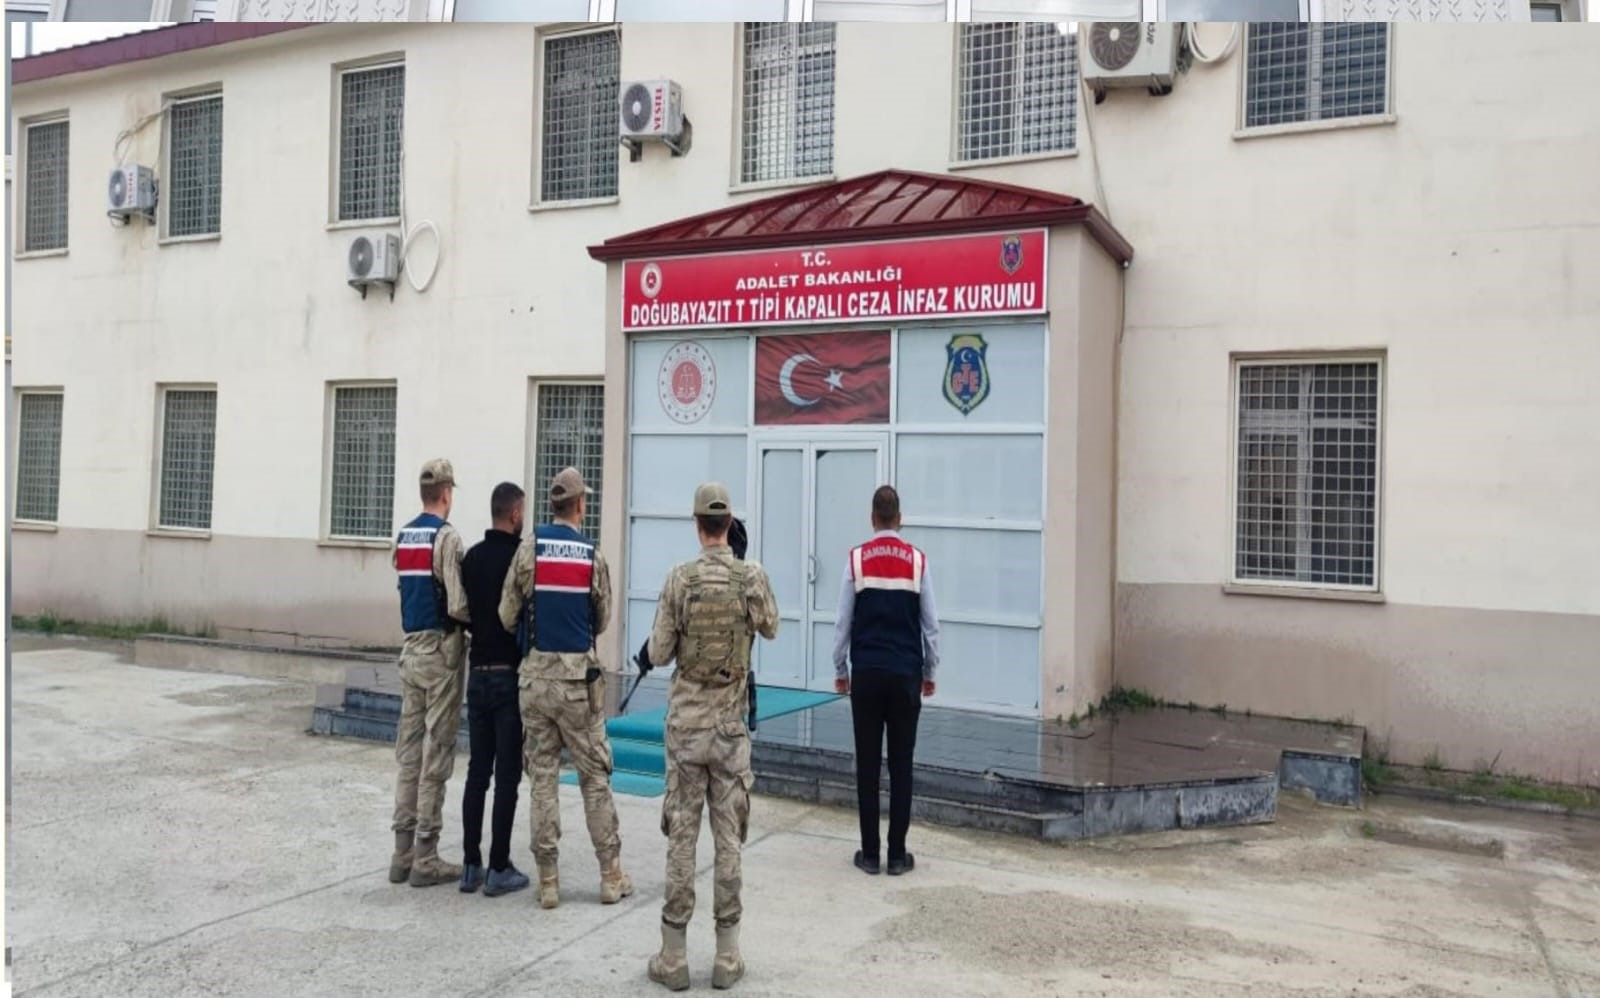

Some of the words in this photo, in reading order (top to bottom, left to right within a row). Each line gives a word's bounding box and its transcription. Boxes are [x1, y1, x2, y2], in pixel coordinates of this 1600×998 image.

[653, 88, 663, 131] VESTEL
[801, 251, 831, 267] T.C.
[736, 274, 799, 291] ADALET
[805, 265, 902, 287] BAKANLIĞI
[631, 299, 731, 326] DOĞUBAYAZIT
[736, 299, 746, 321] T
[751, 291, 780, 320] TİPİ
[784, 293, 842, 319] KAPALI
[847, 291, 892, 316] CEZA
[897, 284, 948, 313] İNFAZ
[954, 282, 1036, 311] KURUMU
[542, 543, 588, 560] JANDARMA
[863, 545, 913, 564] JANDARMA
